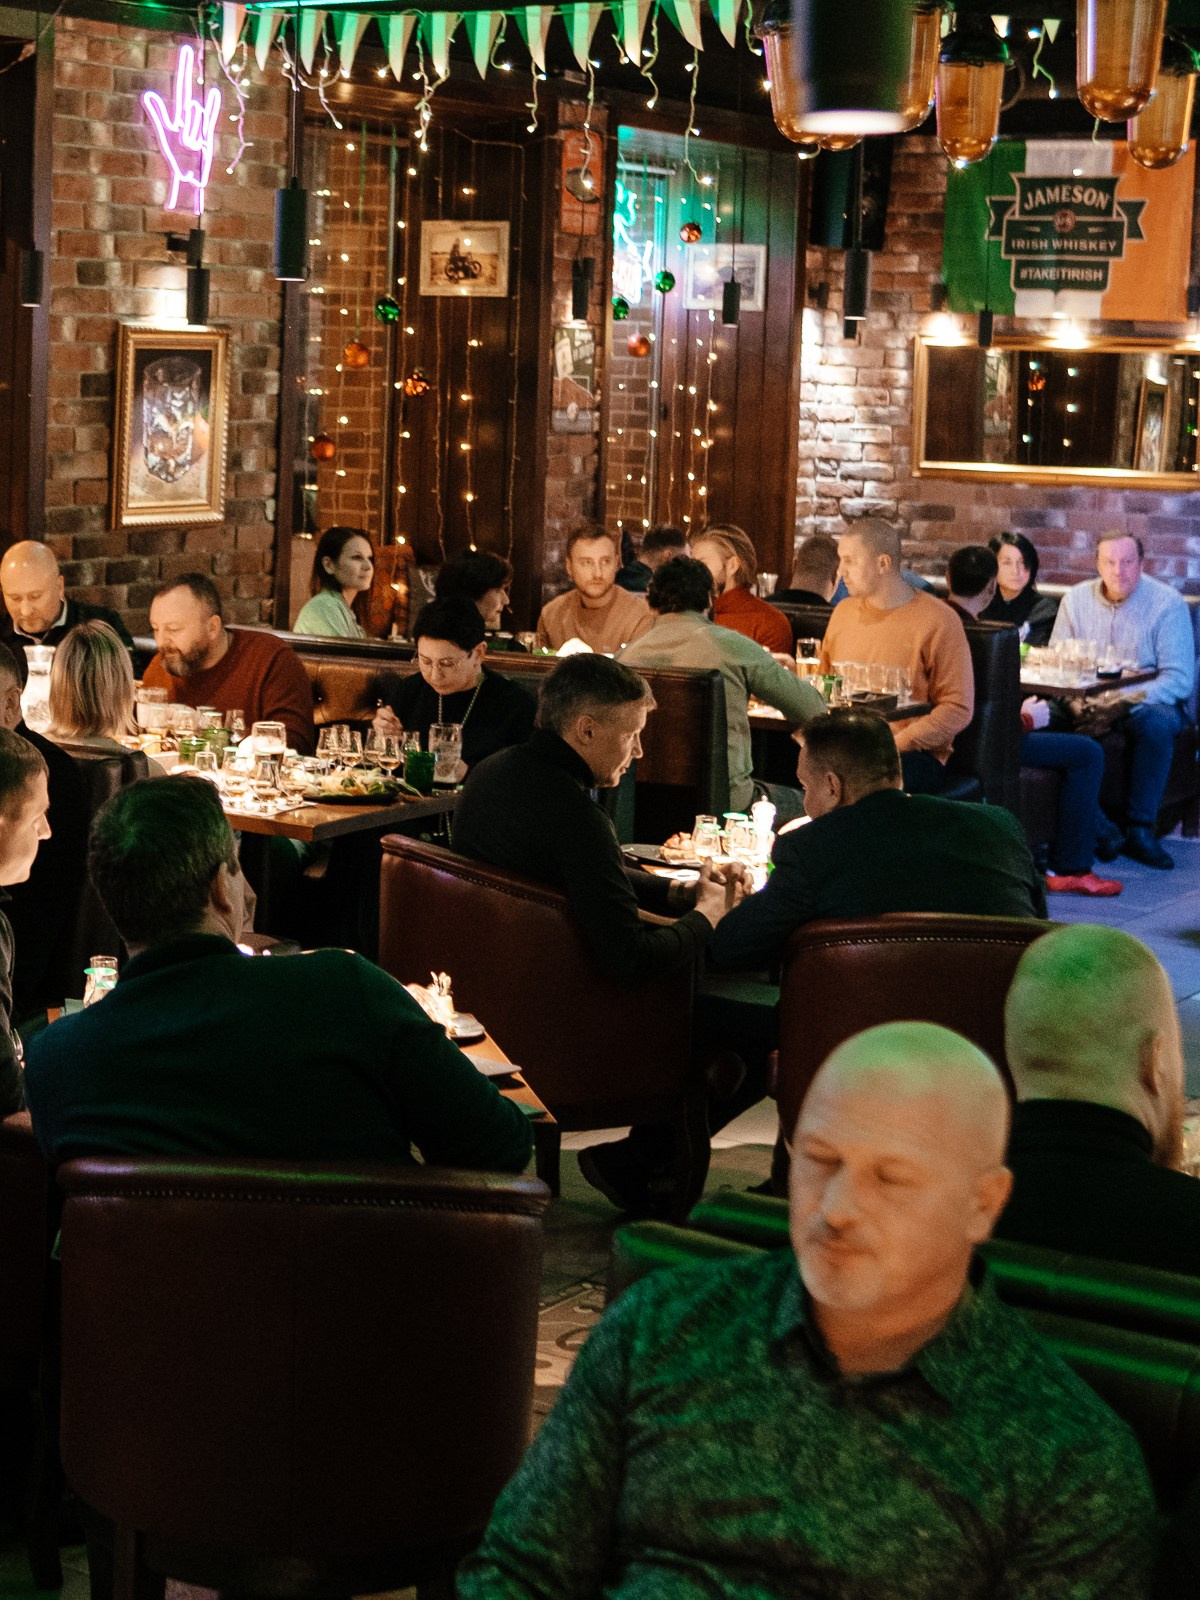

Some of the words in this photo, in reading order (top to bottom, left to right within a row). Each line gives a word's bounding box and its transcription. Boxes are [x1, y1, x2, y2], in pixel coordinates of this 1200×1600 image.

[1023, 184, 1110, 211] JAMESON
[1011, 238, 1048, 250] IRISH
[1051, 239, 1117, 252] WHISKEY
[1019, 267, 1103, 281] #TAKEITIRISH
